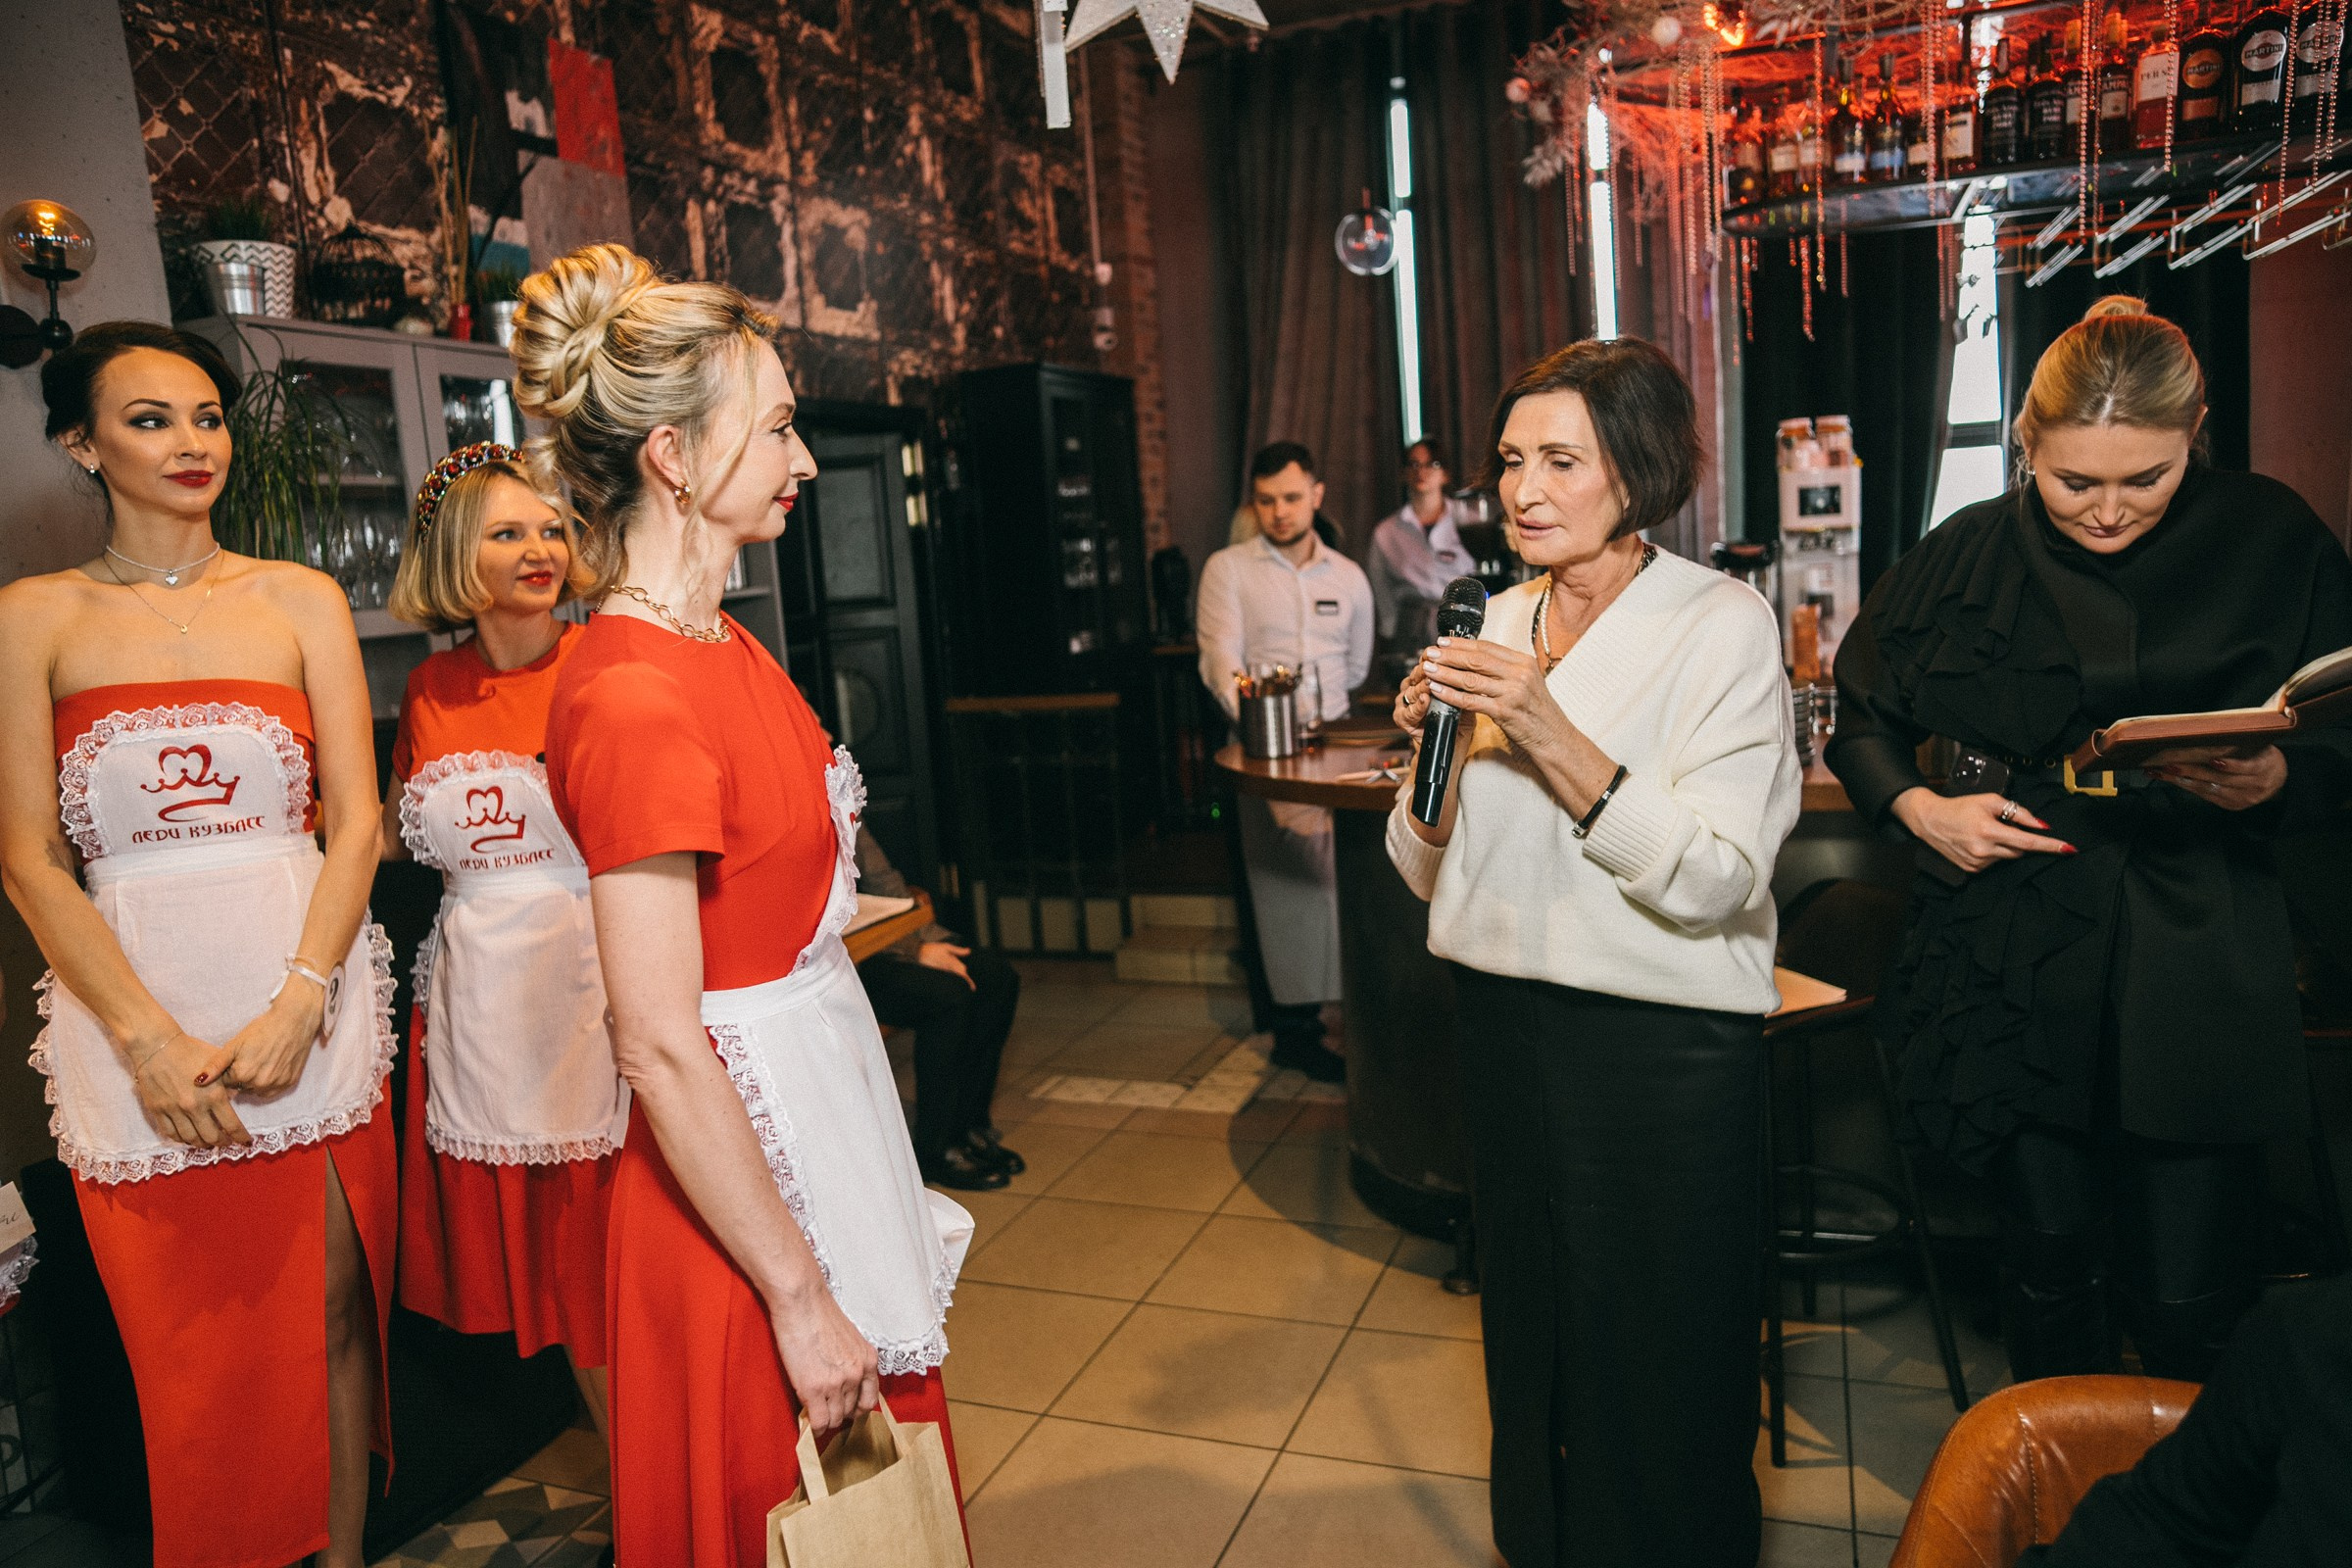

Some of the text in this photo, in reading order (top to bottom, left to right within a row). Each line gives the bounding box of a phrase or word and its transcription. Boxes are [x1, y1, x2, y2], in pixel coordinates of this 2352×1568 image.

[2245, 44, 2283, 58] MARTINI
[2186, 62, 2222, 74] MARTINI
[131, 815, 266, 844] ЛЕДИ КУЗБАСС
[459, 848, 555, 870] ЛЕДИ КУЗБАСС
